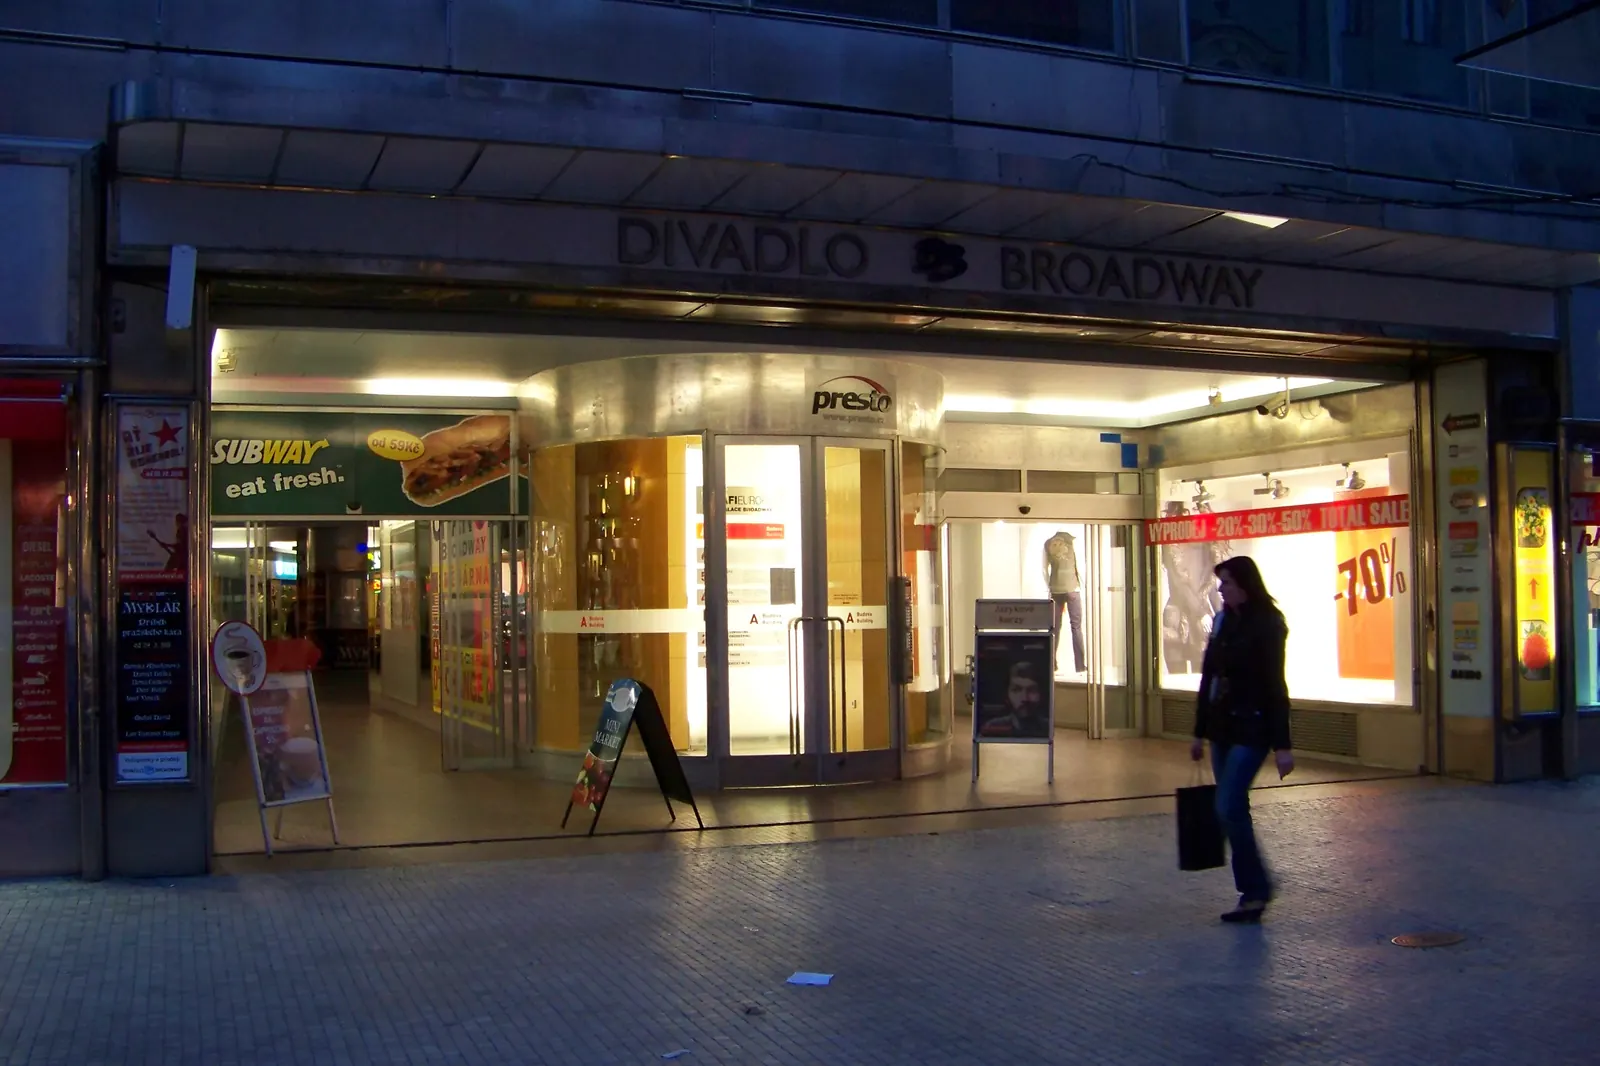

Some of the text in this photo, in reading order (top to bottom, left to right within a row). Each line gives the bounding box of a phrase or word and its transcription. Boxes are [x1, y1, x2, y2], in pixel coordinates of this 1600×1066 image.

[617, 217, 1263, 308] DIVADLO BROADWAY
[812, 390, 892, 414] presto
[210, 438, 330, 464] SUBWAY
[371, 436, 386, 448] od
[226, 467, 345, 498] eat fresh.
[1320, 504, 1366, 529] TOTAL
[1370, 499, 1409, 526] SALE
[22, 541, 53, 552] DIESEL
[1334, 537, 1406, 616] -70%
[581, 616, 587, 628] A
[750, 614, 758, 624] A
[847, 612, 854, 623] A
[604, 719, 621, 734] MINI
[594, 731, 622, 749] MARKET
